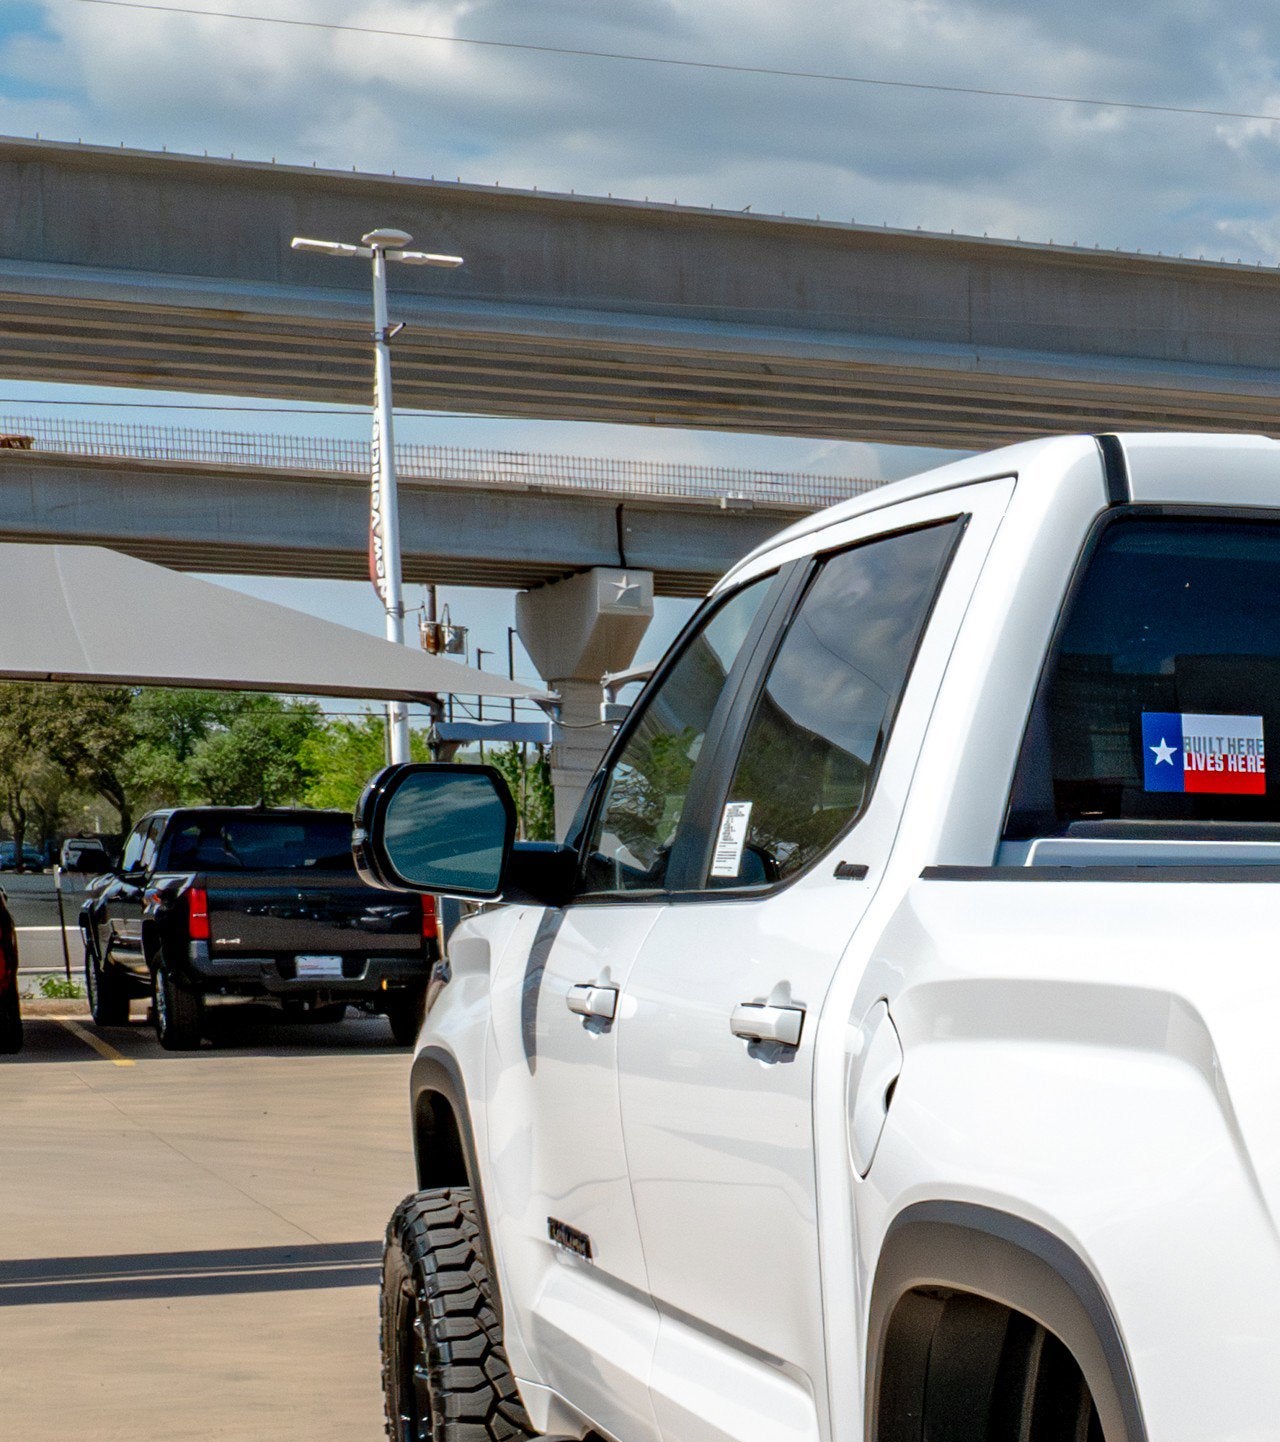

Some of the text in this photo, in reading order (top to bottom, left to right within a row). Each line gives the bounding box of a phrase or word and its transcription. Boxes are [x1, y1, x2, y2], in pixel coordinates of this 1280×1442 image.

[1183, 736, 1264, 755] BUILT HERE
[1184, 752, 1265, 773] LIVES HERE
